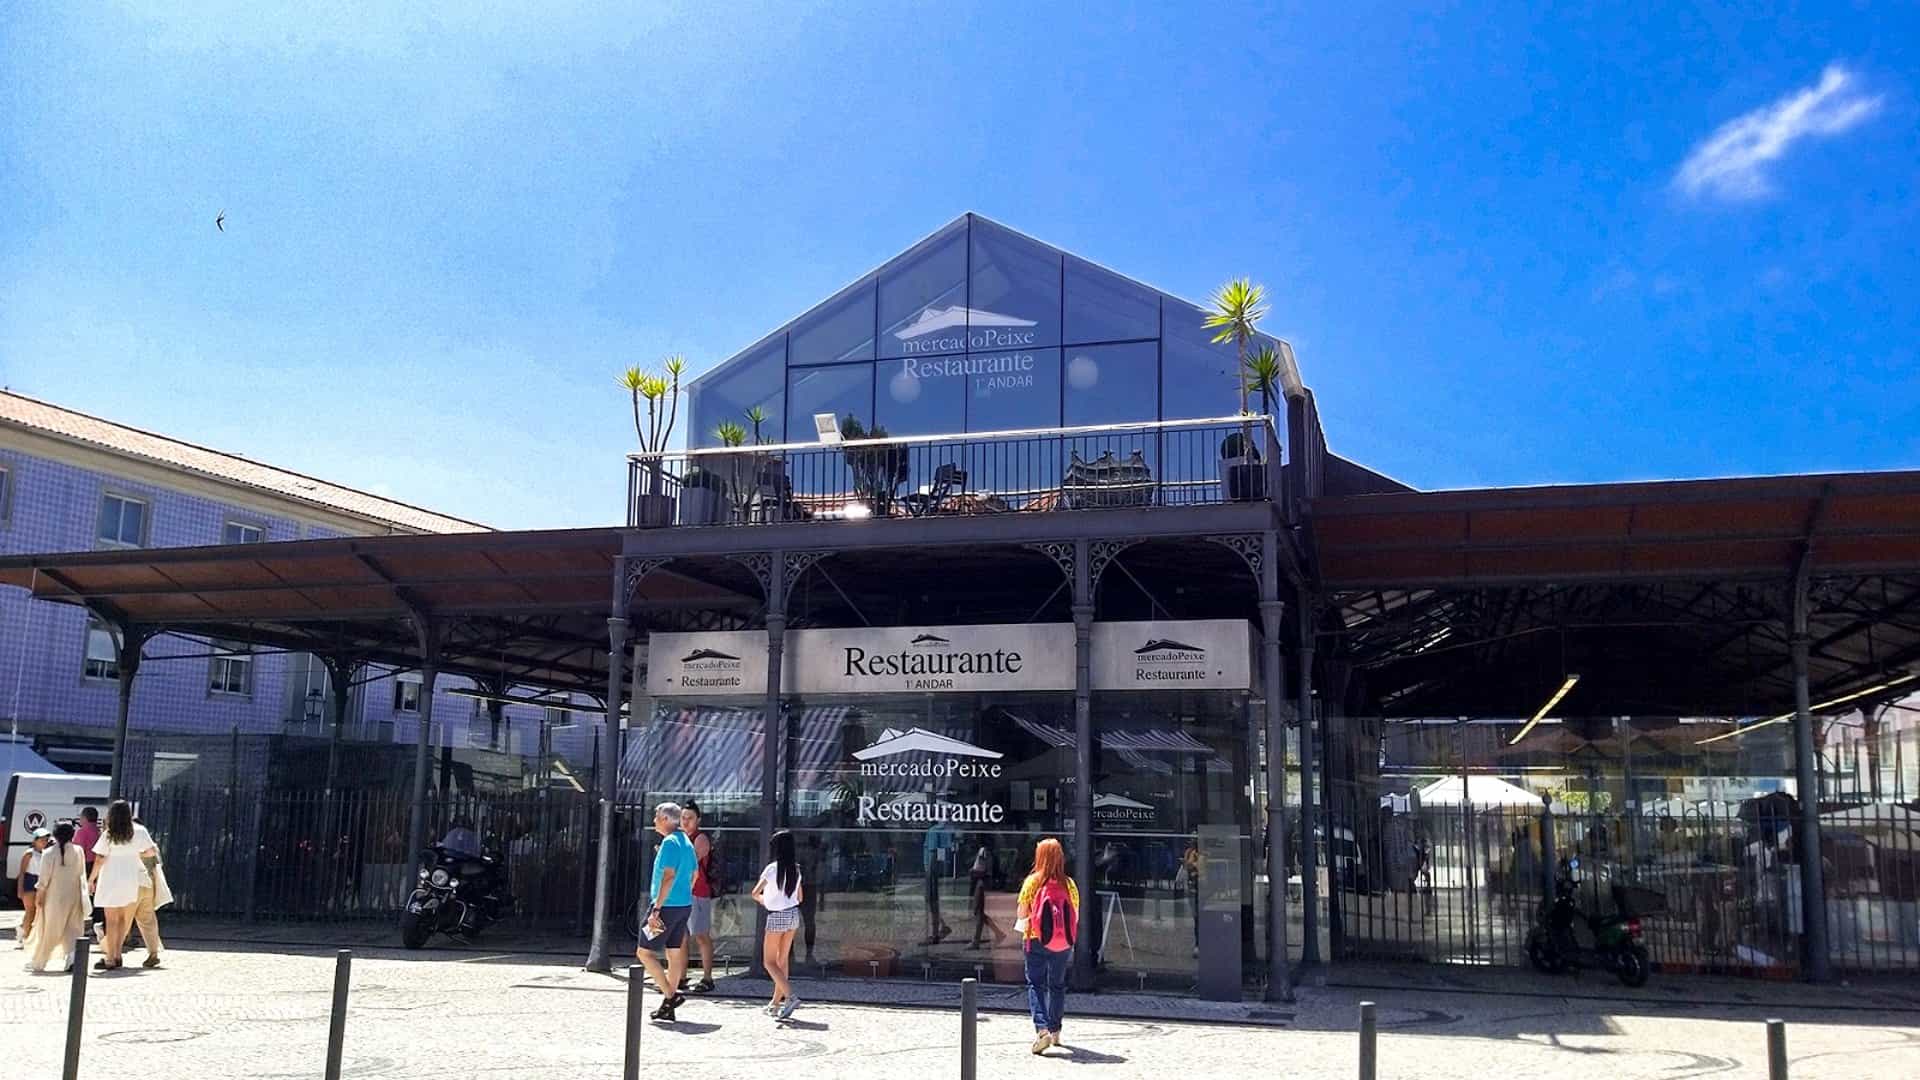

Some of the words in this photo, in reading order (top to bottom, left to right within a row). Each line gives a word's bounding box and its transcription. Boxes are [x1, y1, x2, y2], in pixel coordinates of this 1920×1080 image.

[902, 328, 1035, 353] mercadoPeixe
[902, 353, 1034, 379] Restaurante
[987, 375, 1033, 390] ANDAR
[844, 647, 1022, 676] Restaurante
[1137, 651, 1205, 662] mercadoPeixe
[681, 675, 741, 687] Restaurante
[1136, 668, 1206, 681] Restaurante
[915, 679, 953, 689] ANDAR
[860, 758, 1001, 778] mercadoPeixe
[856, 795, 1004, 823] Restaurante
